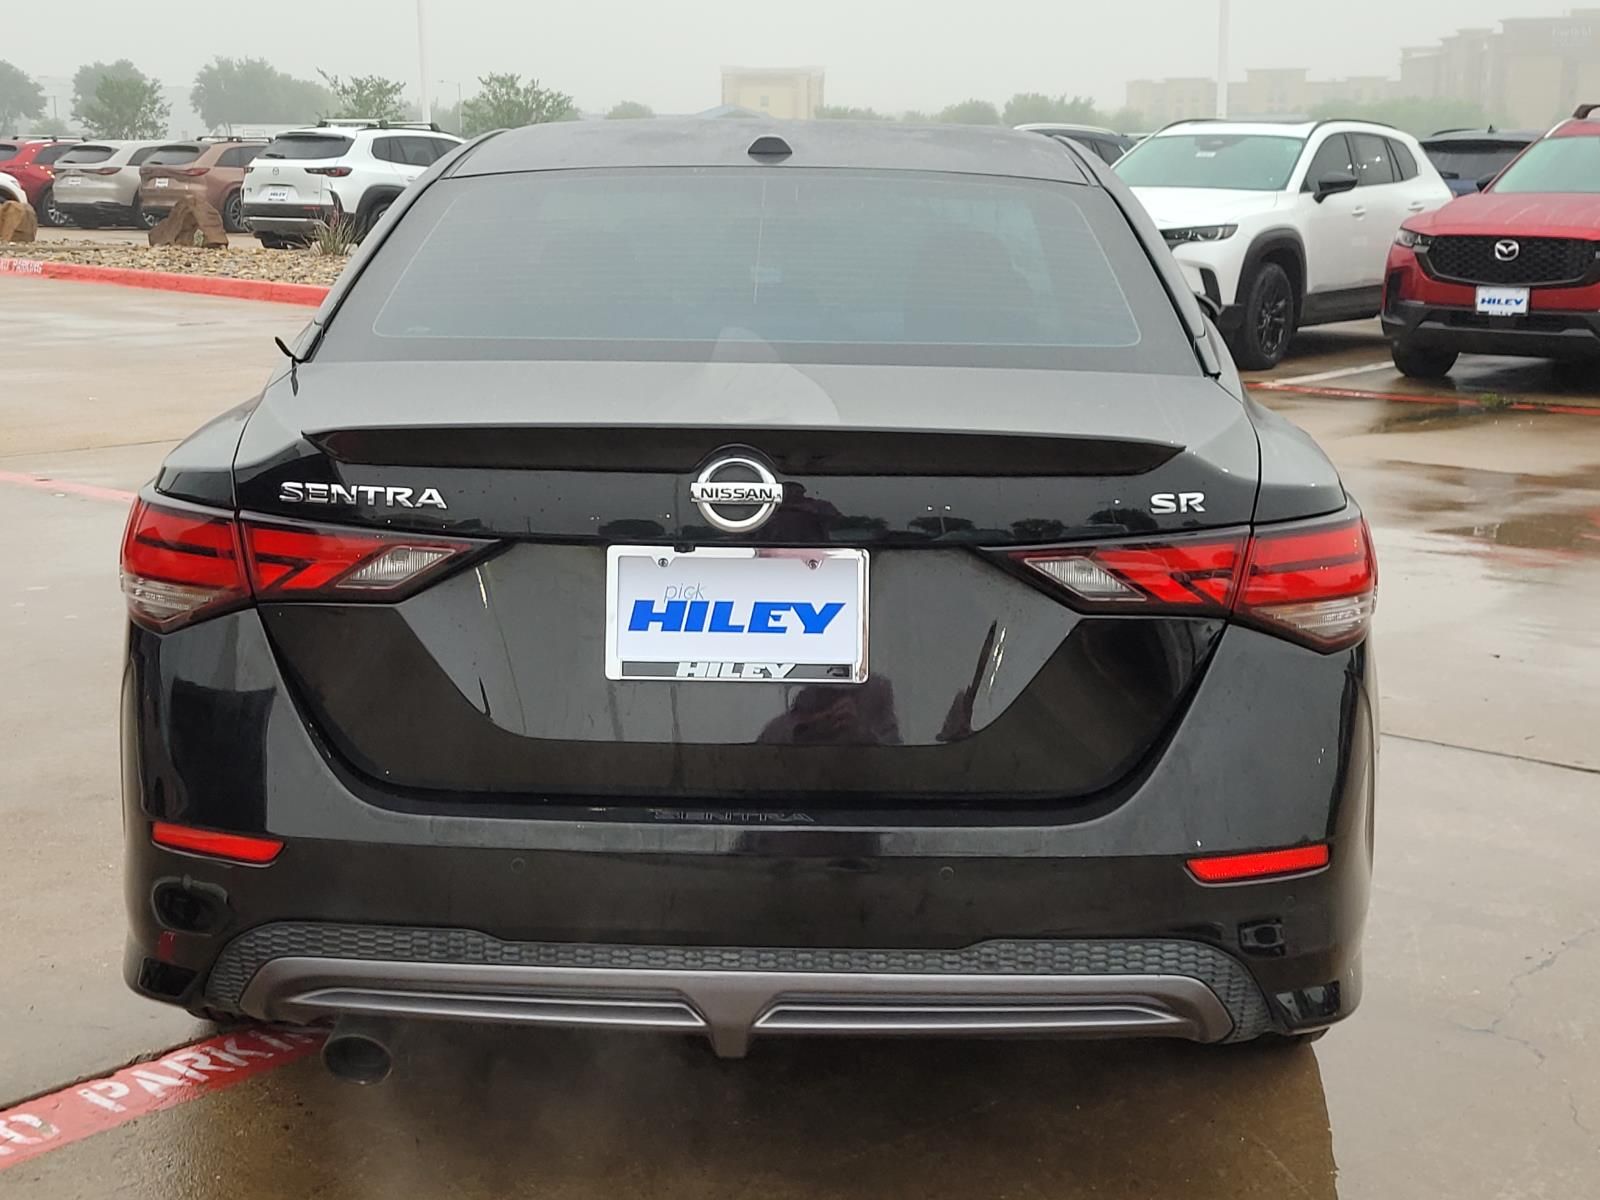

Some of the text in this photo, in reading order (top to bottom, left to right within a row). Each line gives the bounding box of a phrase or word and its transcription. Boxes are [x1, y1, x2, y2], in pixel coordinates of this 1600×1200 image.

[279, 481, 448, 510] SENTRA
[701, 486, 773, 500] NISSAN
[1150, 492, 1206, 514] SR
[663, 582, 706, 603] pick
[628, 599, 846, 634] HILEY
[675, 661, 798, 679] HILEY
